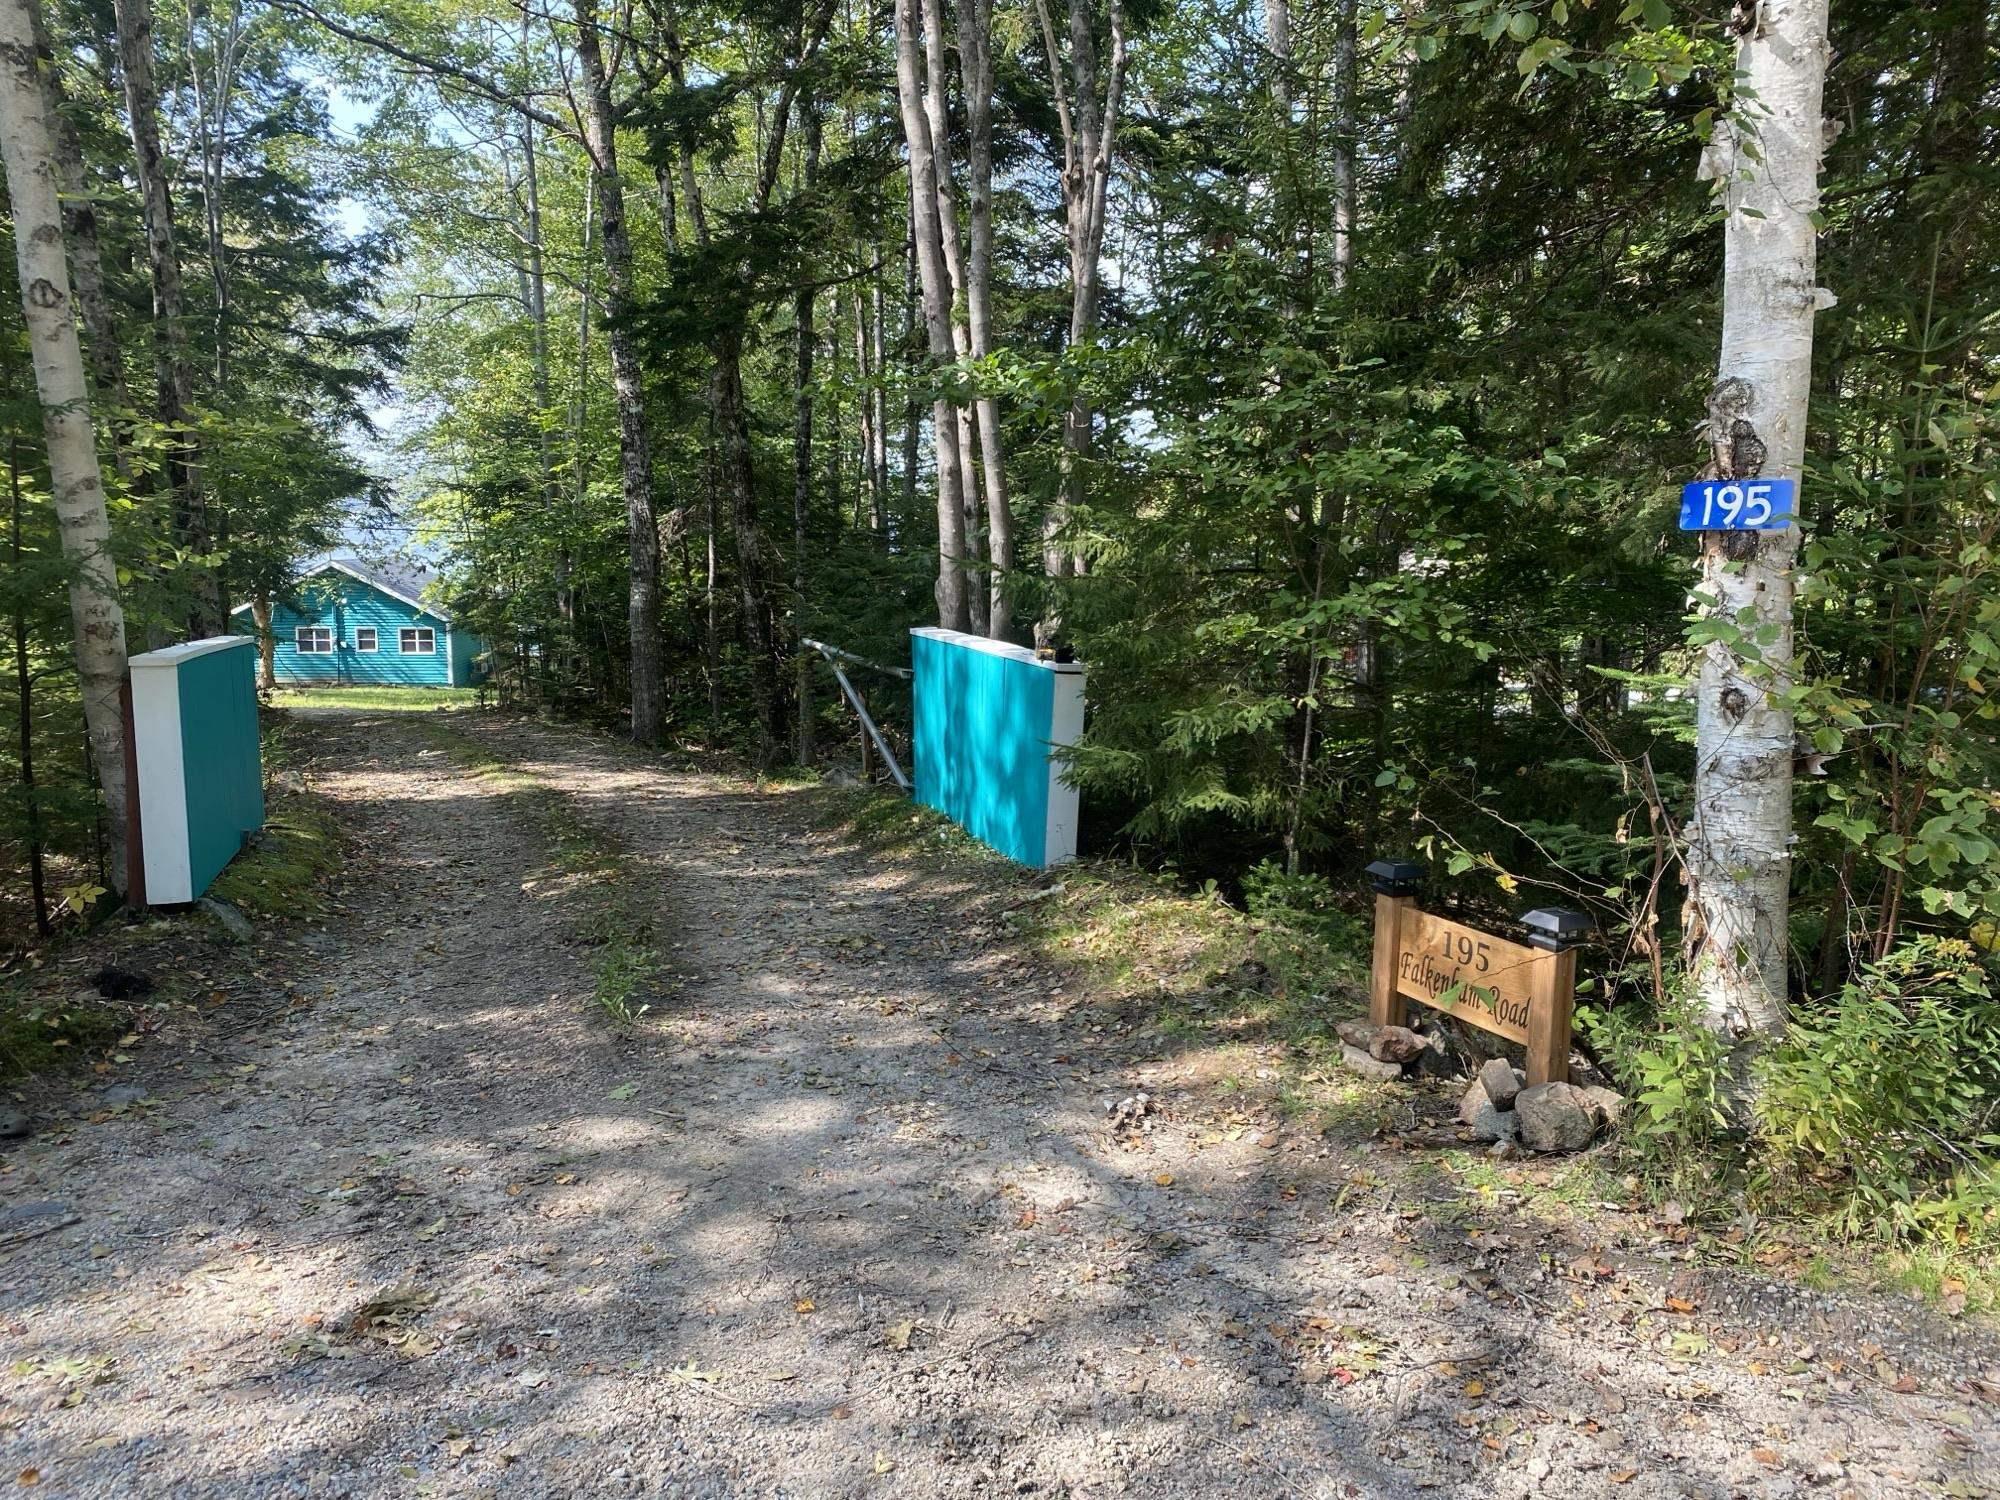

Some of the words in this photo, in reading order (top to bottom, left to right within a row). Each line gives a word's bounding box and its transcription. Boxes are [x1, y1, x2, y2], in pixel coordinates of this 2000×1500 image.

[1702, 485, 1772, 526] 195
[1442, 931, 1490, 972] 195
[1487, 985, 1531, 1029] Road
